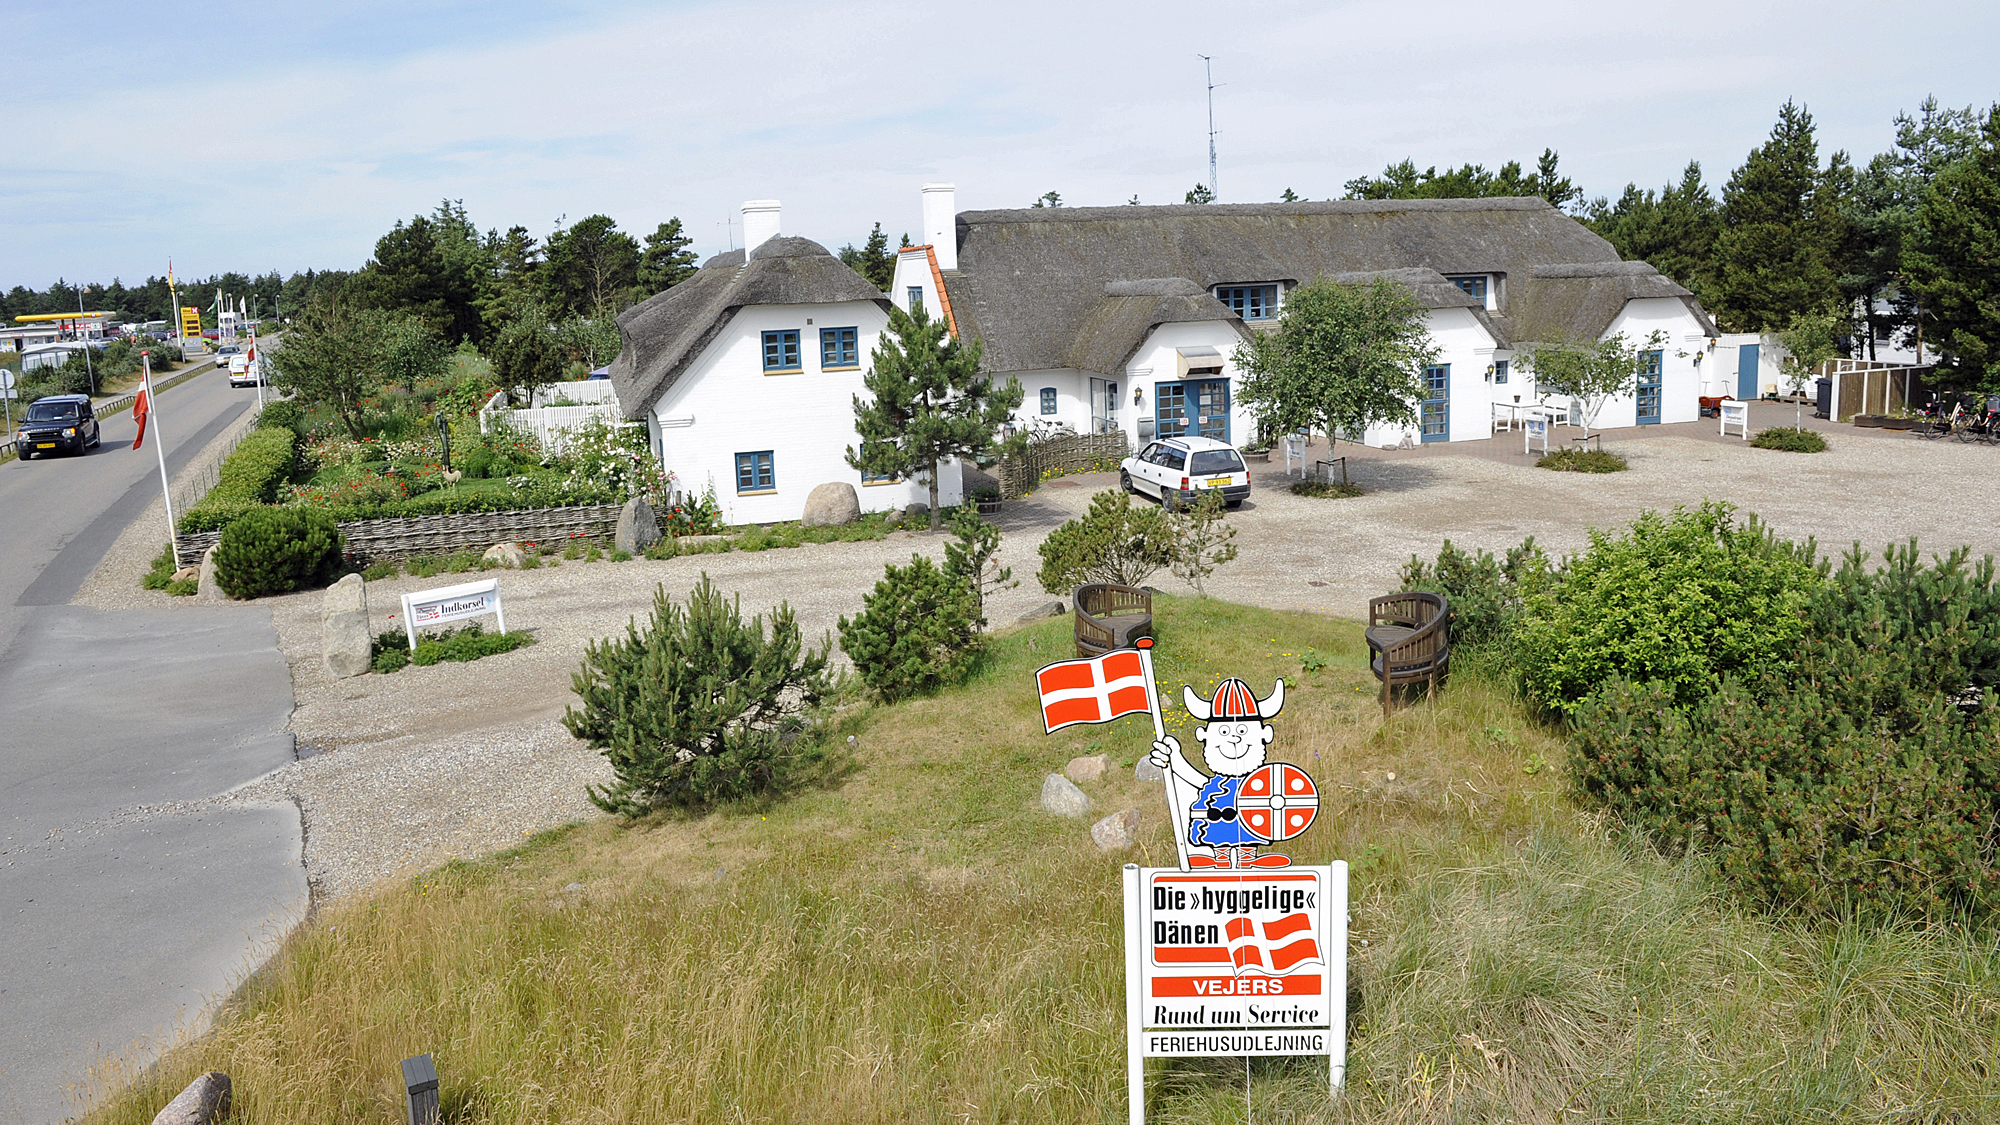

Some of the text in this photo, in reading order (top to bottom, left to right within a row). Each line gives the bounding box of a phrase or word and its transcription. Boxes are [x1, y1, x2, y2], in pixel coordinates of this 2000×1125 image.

[1153, 886, 1186, 910] Die
[1153, 920, 1219, 944] Dänen
[1192, 978, 1284, 995] VEJERS
[1153, 1003, 1319, 1025] Rund um Service
[1150, 1034, 1323, 1053] FERIEHUSUDLEJNING
